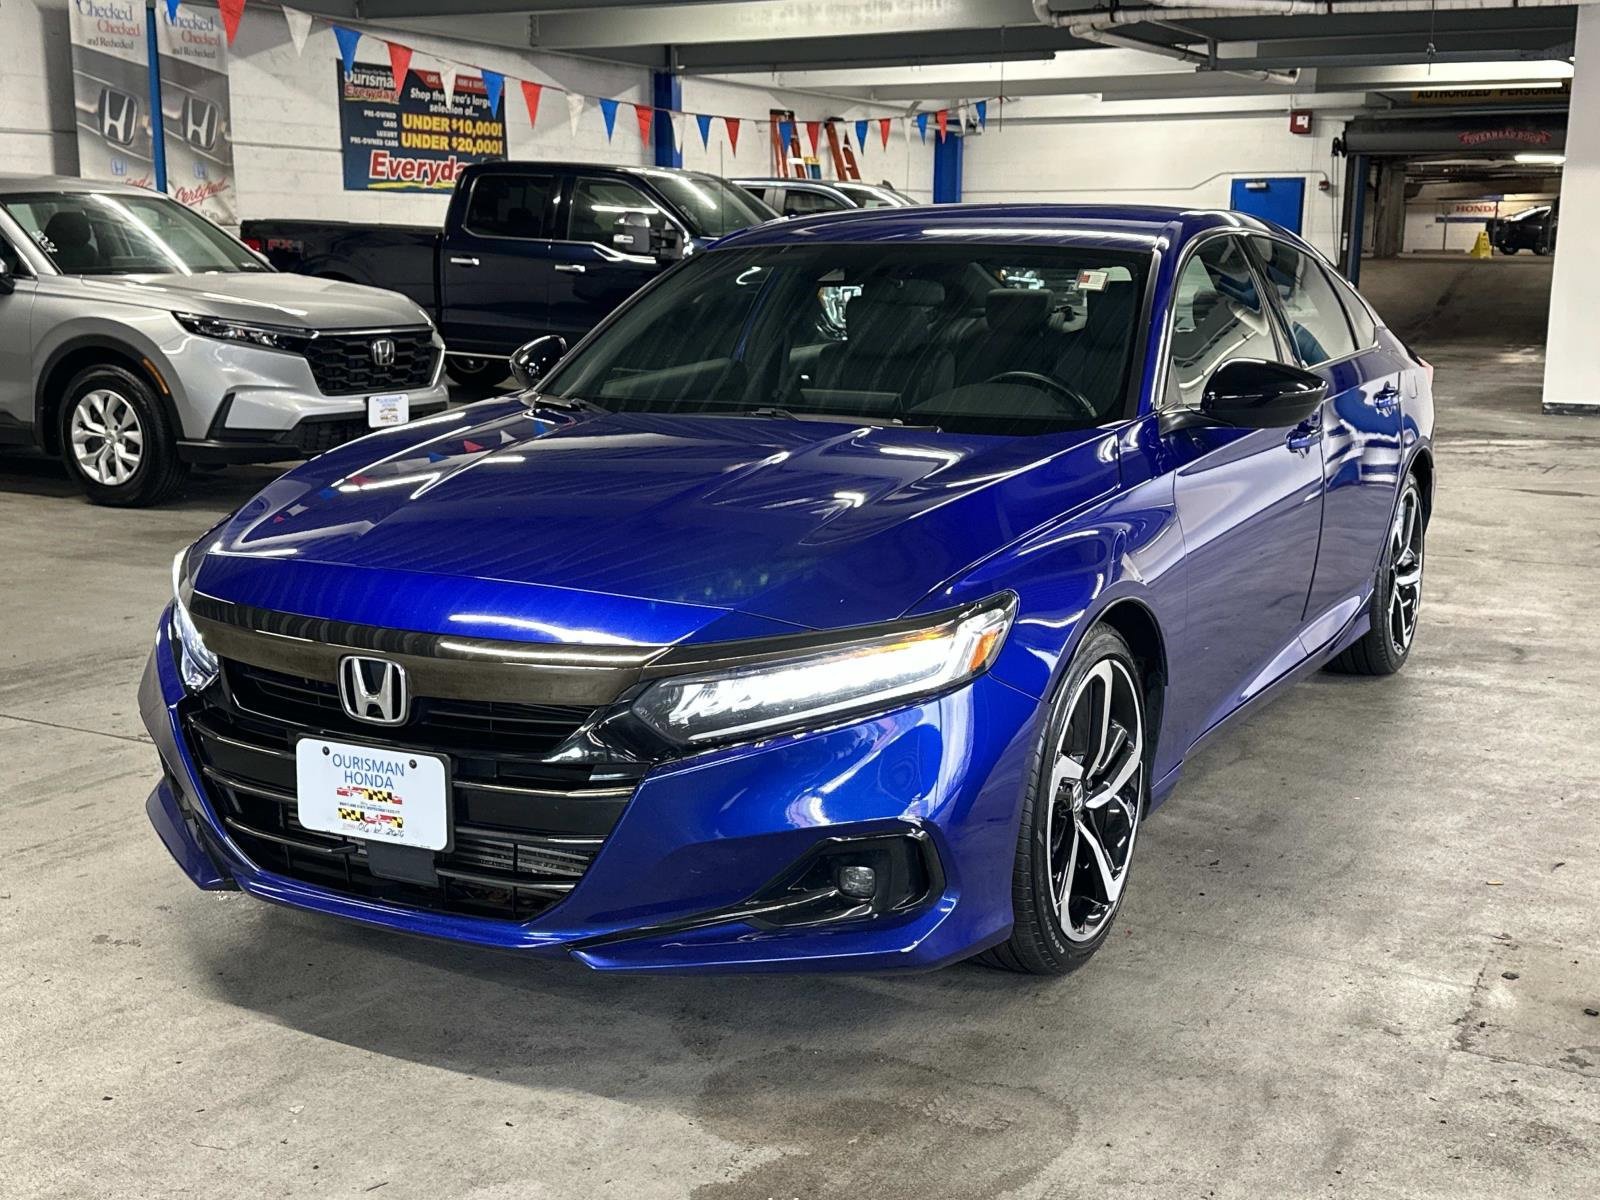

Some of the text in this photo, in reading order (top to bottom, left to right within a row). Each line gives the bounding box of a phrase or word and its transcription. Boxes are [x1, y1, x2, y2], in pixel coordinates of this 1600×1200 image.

[76, 0, 133, 21] Checked
[97, 19, 141, 37] Checked
[344, 70, 397, 89] Ourisma
[410, 88, 431, 102] Shop
[432, 90, 445, 101] the
[402, 113, 503, 137] UNDER $10,000!
[401, 132, 503, 156] UNDER $20,000!
[332, 753, 405, 777] OURISMAN
[344, 770, 394, 790] HONDA
